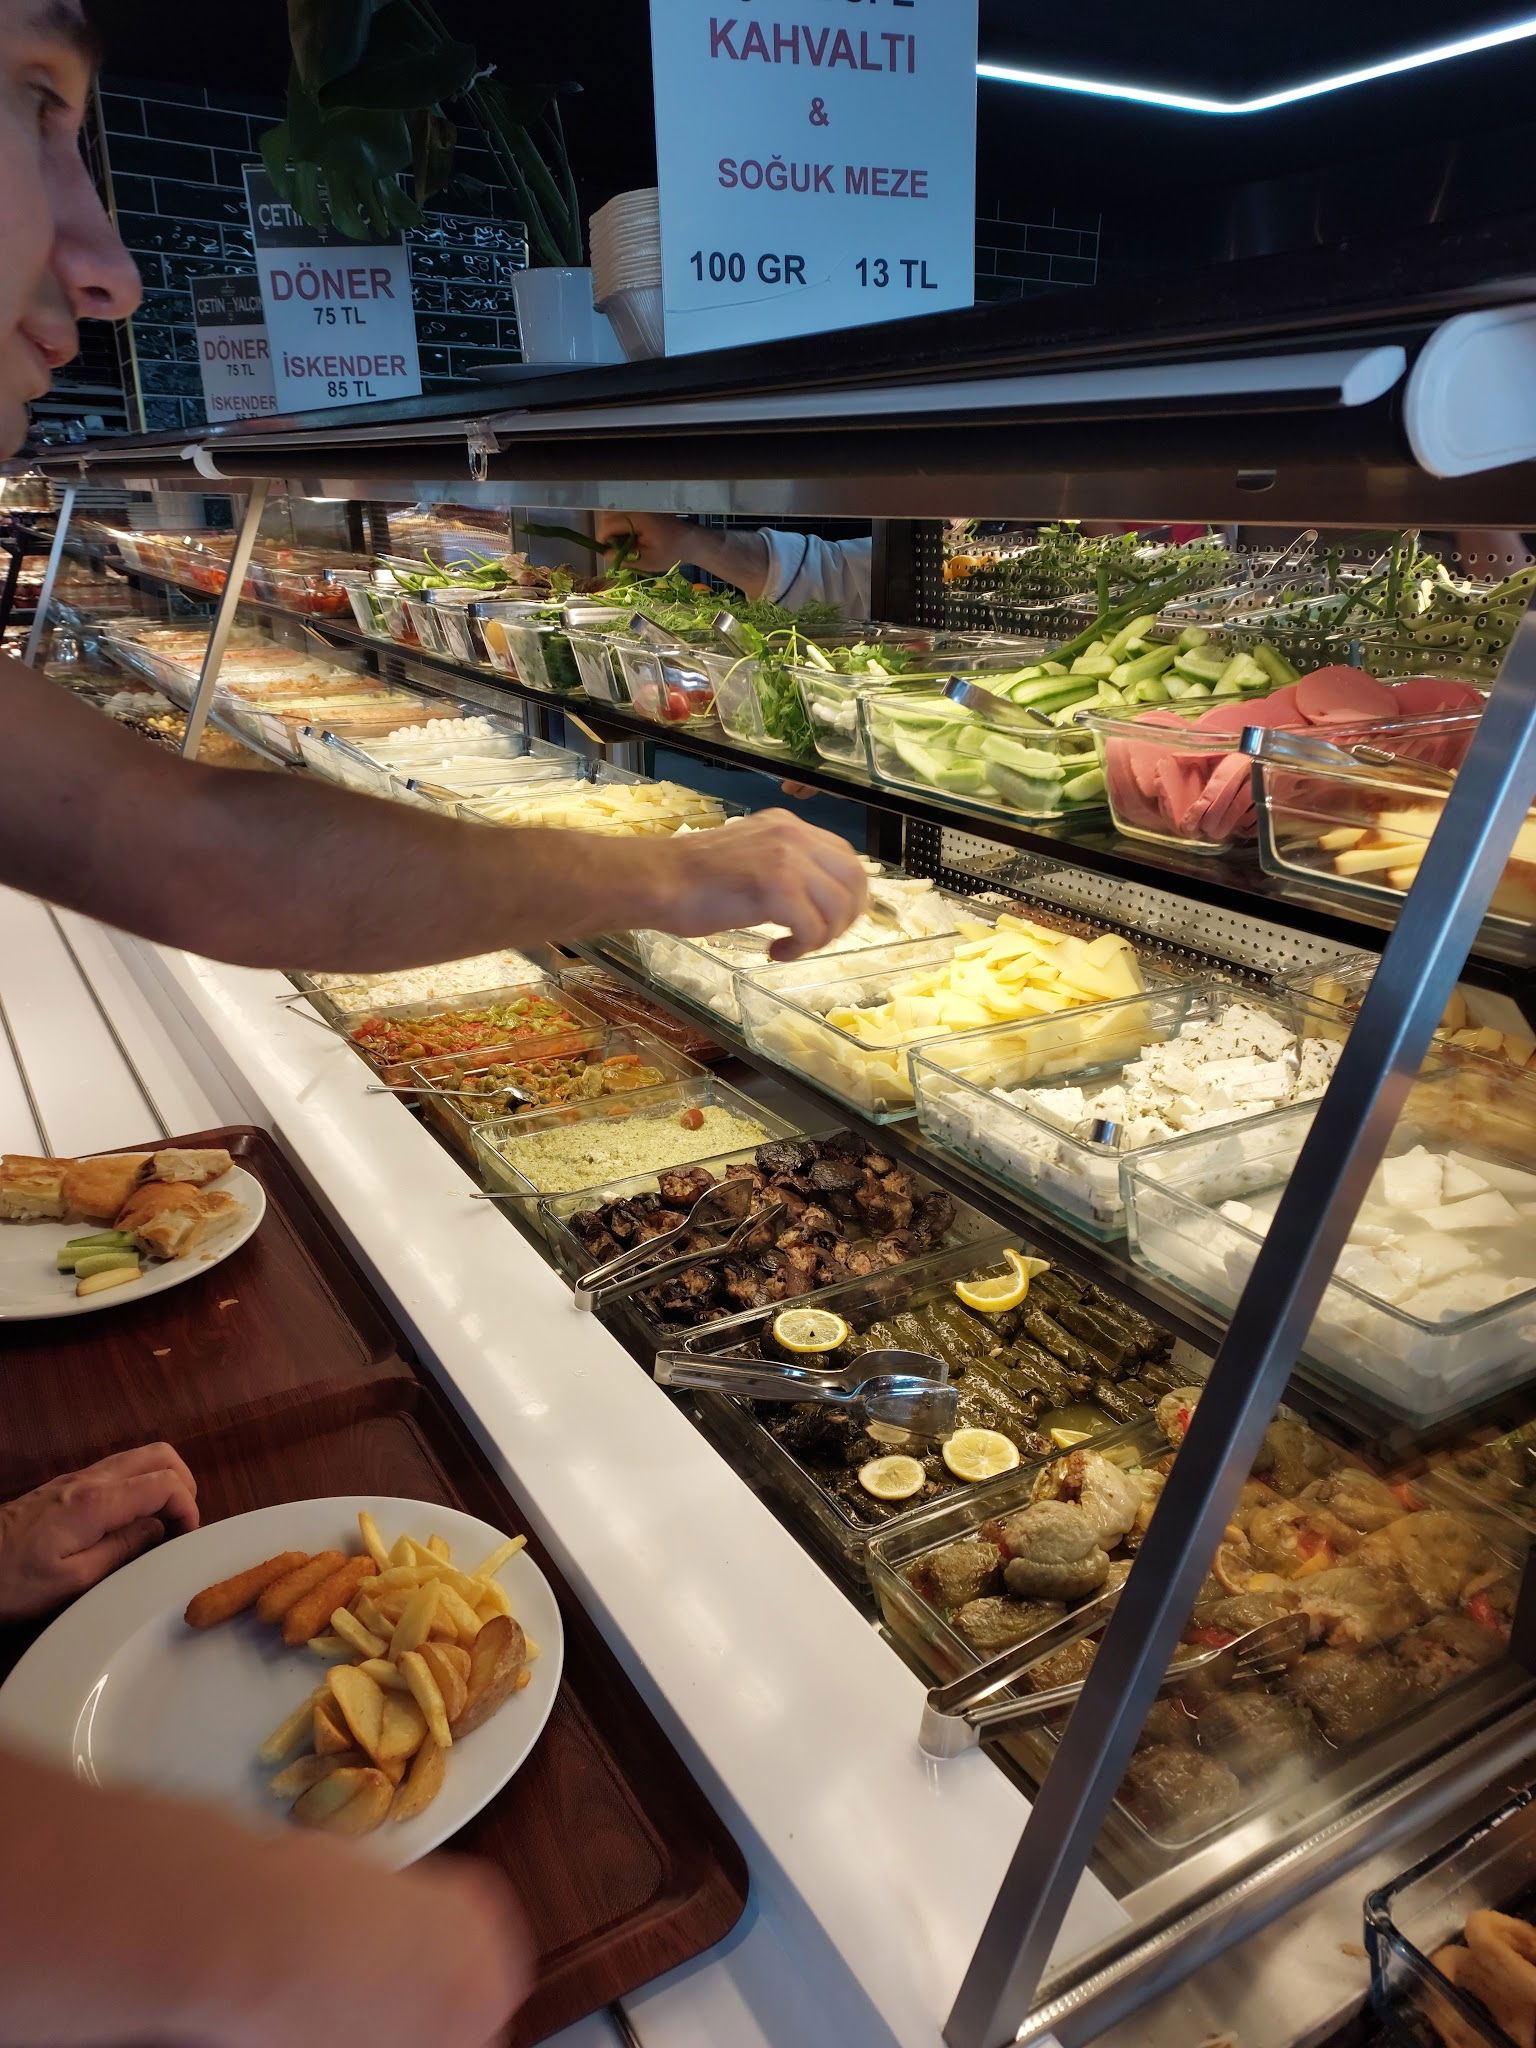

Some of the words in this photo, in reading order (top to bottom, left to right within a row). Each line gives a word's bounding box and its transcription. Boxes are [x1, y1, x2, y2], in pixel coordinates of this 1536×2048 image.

[709, 17, 915, 73] KAHVALTI
[808, 97, 829, 126] &
[718, 154, 835, 193] SOĞUK
[845, 165, 929, 199] MEZE
[270, 262, 396, 301] DÖNER
[690, 250, 746, 283] 100
[757, 253, 807, 285] GR
[855, 257, 889, 288] 13
[899, 259, 938, 289] TL
[314, 307, 336, 325] 75
[341, 306, 367, 325] TL
[203, 336, 270, 361] DÖNER
[226, 364, 239, 377] 75
[241, 363, 255, 376] TL
[283, 351, 408, 378] İSKENDER
[211, 394, 277, 411] İSKENDER
[327, 381, 348, 398] 85
[352, 380, 377, 398] TL
